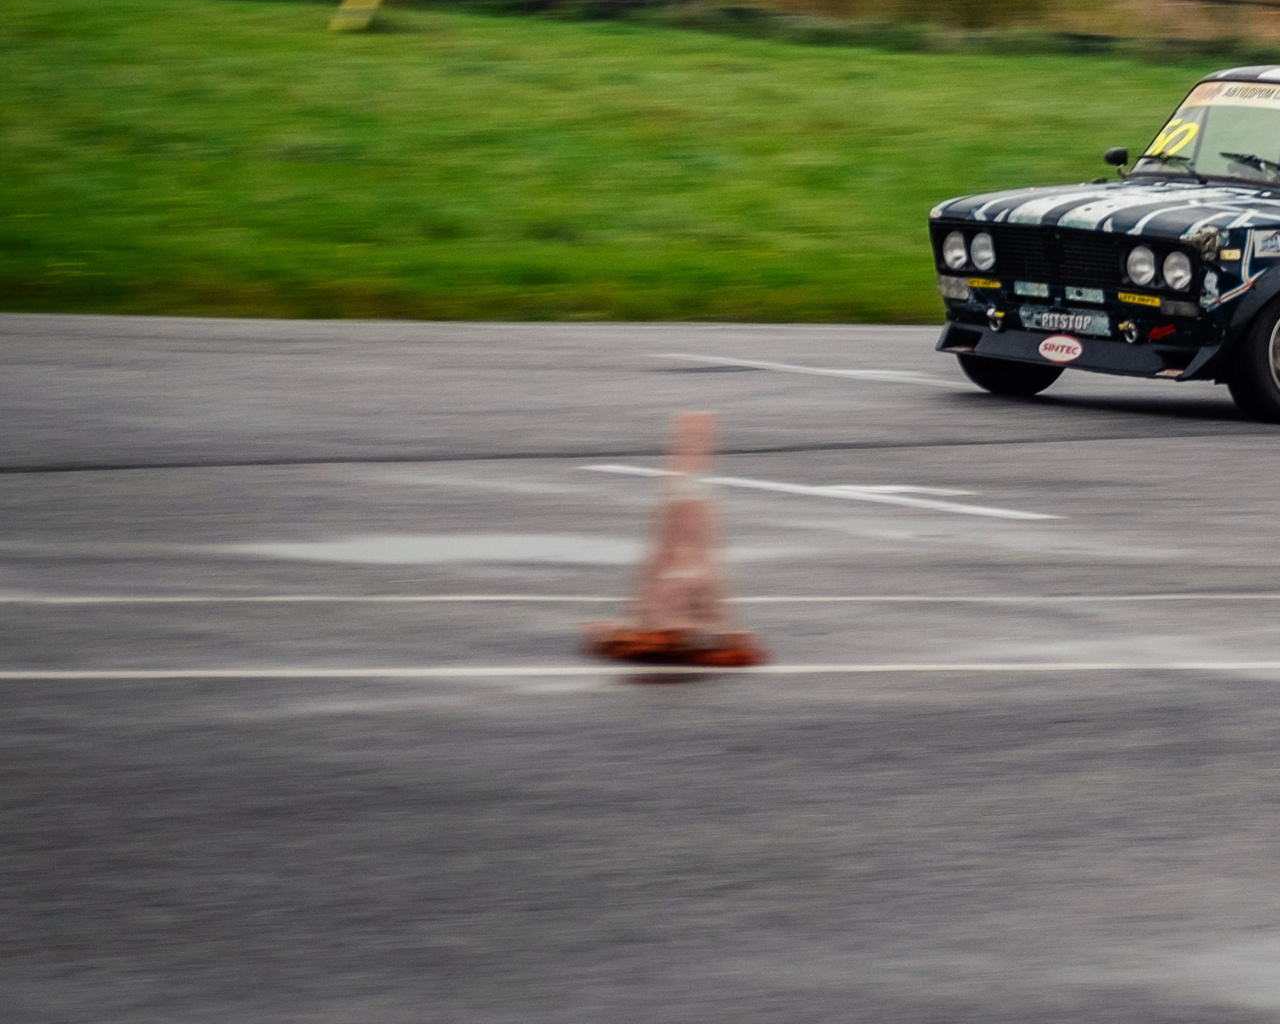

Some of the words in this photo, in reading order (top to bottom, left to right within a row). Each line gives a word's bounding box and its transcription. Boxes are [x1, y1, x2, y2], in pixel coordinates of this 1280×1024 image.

[1223, 85, 1276, 101] АВТОДРОМ
[1041, 312, 1092, 330] PITSTOP
[1042, 342, 1079, 355] SINTEC
